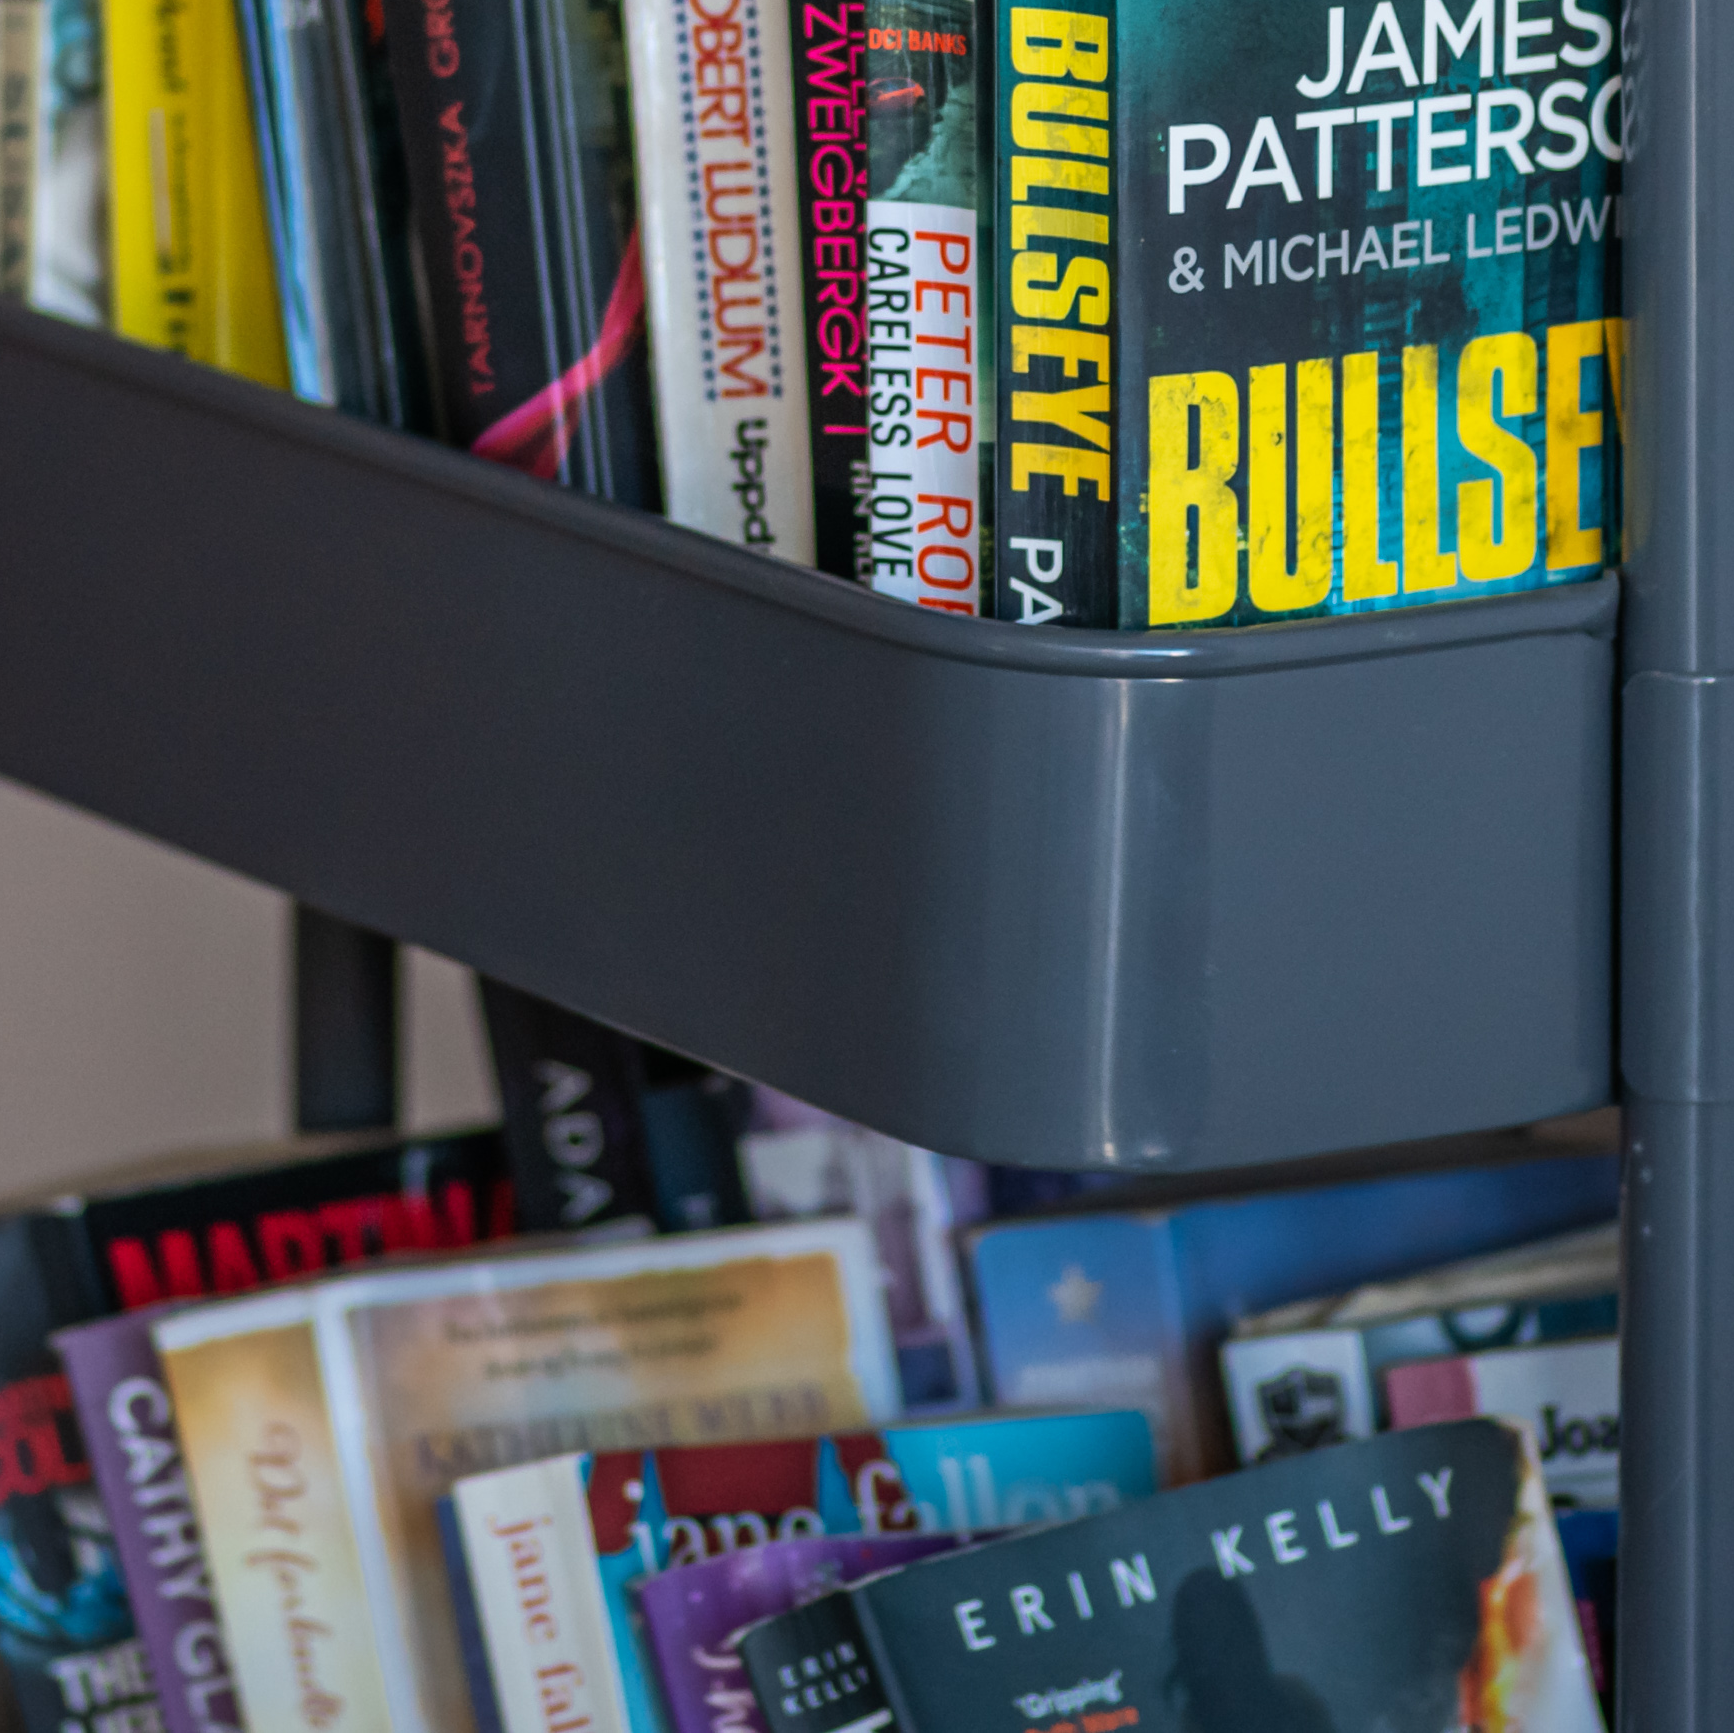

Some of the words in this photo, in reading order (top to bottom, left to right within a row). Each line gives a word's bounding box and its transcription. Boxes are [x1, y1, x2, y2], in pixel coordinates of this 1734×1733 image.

[868, 27, 903, 51] DCI
[908, 29, 967, 57] BANKS
[701, 162, 770, 400] LUDLUM
[804, 2, 865, 398] ZWEIGBERGK
[1010, 6, 1111, 503] BULLSEYE
[1168, 246, 1206, 295] &
[1223, 219, 1451, 291] MICHAEL
[868, 225, 912, 449] CARELESS
[915, 230, 973, 456] PETER
[871, 472, 914, 579] LOVE
[1008, 536, 1064, 626] PA
[108, 1376, 212, 1603] CATHY
[490, 1511, 561, 1644] jane
[952, 1552, 1161, 1652] ERIN
[1211, 1467, 1456, 1580] KELLY
